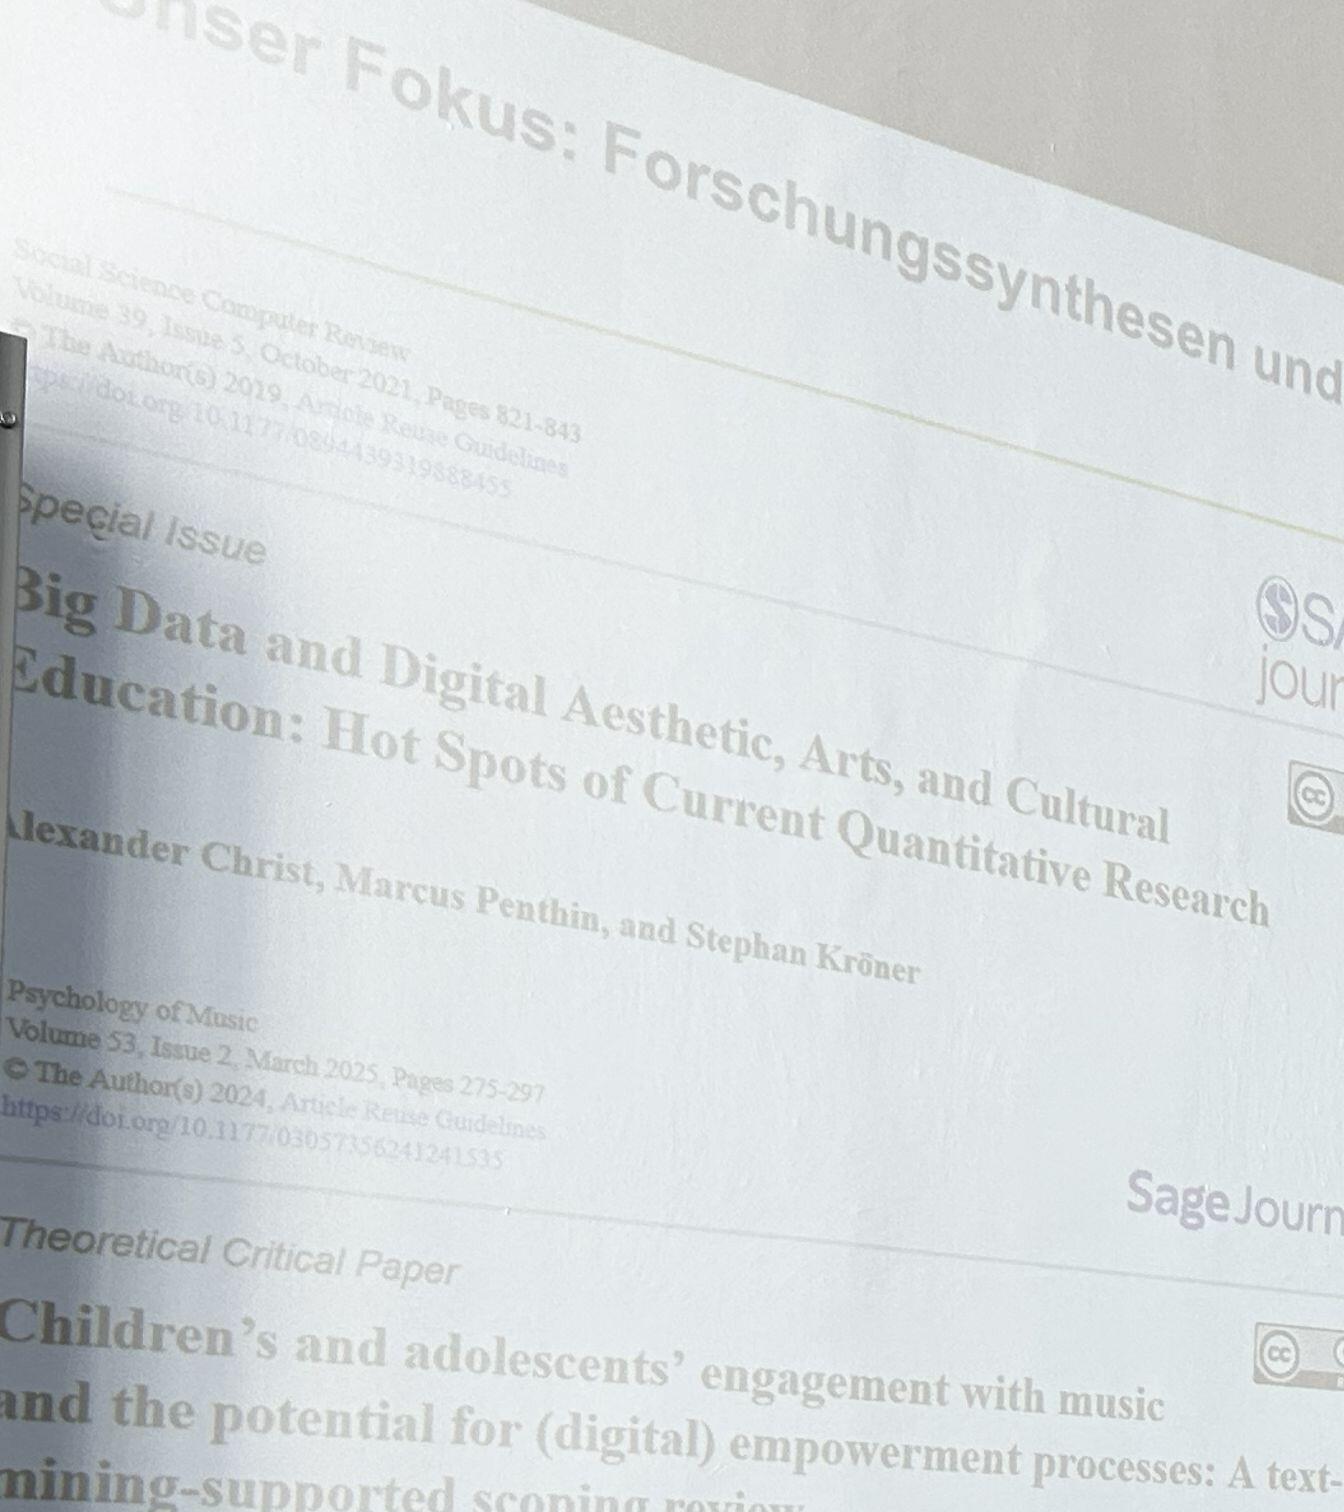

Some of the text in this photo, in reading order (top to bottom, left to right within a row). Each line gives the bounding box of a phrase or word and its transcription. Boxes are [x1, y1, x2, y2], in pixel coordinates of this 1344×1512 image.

[346, 35, 576, 163] Fokus:
[604, 120, 1235, 371] Forschungssynthesen
[1255, 345, 1343, 405] und
[260, 342, 582, 444] October Pages 821-843
[18, 480, 267, 566] Special Issue
[14, 563, 1170, 845] Big Data and Digital Aesthetic, Arts, and Cultural
[10, 642, 1270, 929] Education: Hot Spots Current Quantitative Research
[201, 841, 324, 894] Christ,
[335, 862, 465, 910] Marcus
[476, 885, 610, 939] Penthin,
[686, 921, 806, 967] Stephan
[817, 942, 922, 985] Kröner
[6, 1016, 211, 1063] Volume Issue
[7, 979, 258, 1033] Psychology Music
[1127, 1168, 1230, 1231] Sage
[0, 1216, 462, 1289] Theoretical Critical Paper
[295, 1326, 386, 1367] and
[701, 1365, 950, 1409] engagement
[961, 1374, 1045, 1414] with
[1058, 1386, 1165, 1422] music
[0, 1380, 1343, 1494] and the potential for (digital) empowerment processes: text-
